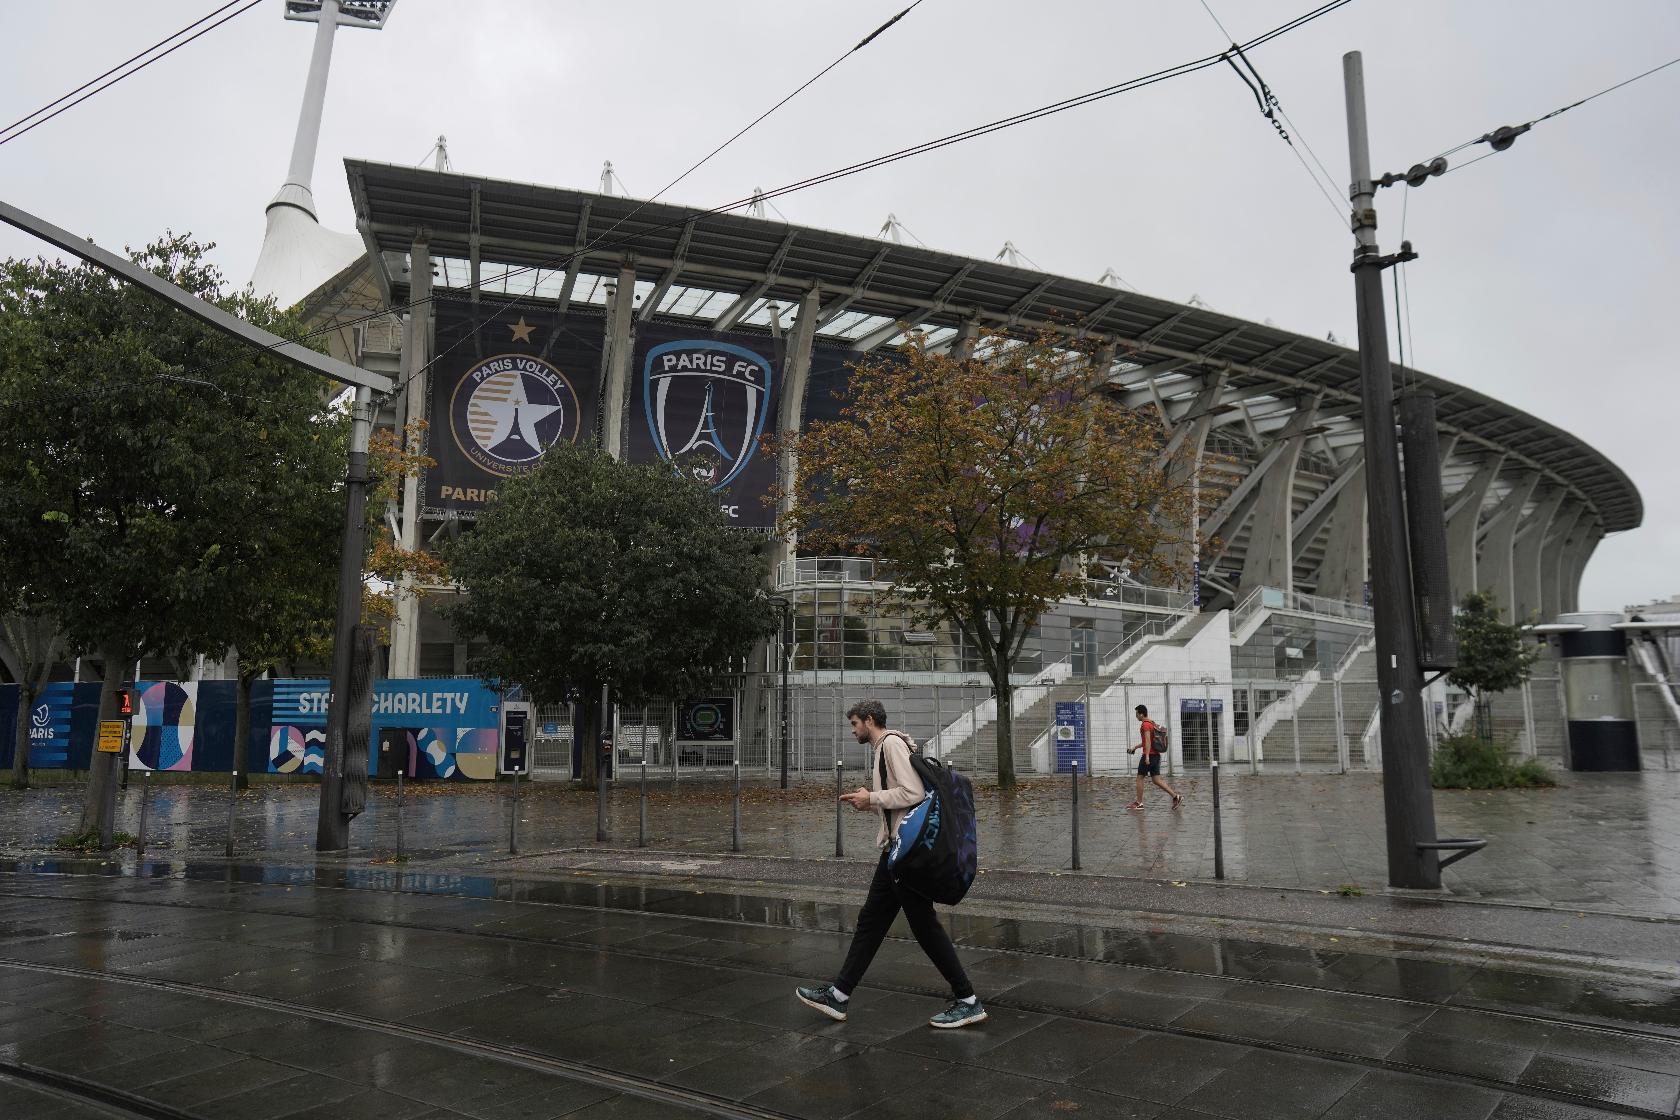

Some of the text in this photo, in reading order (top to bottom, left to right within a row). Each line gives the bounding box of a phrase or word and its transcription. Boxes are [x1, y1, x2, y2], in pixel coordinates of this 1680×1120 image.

[472, 359, 565, 390] PARIS VOLLEY
[662, 353, 759, 381] PARIS FC
[441, 485, 499, 502] PARIS
[298, 692, 469, 714] STA CHARLETY
[30, 728, 54, 739] ARIS
